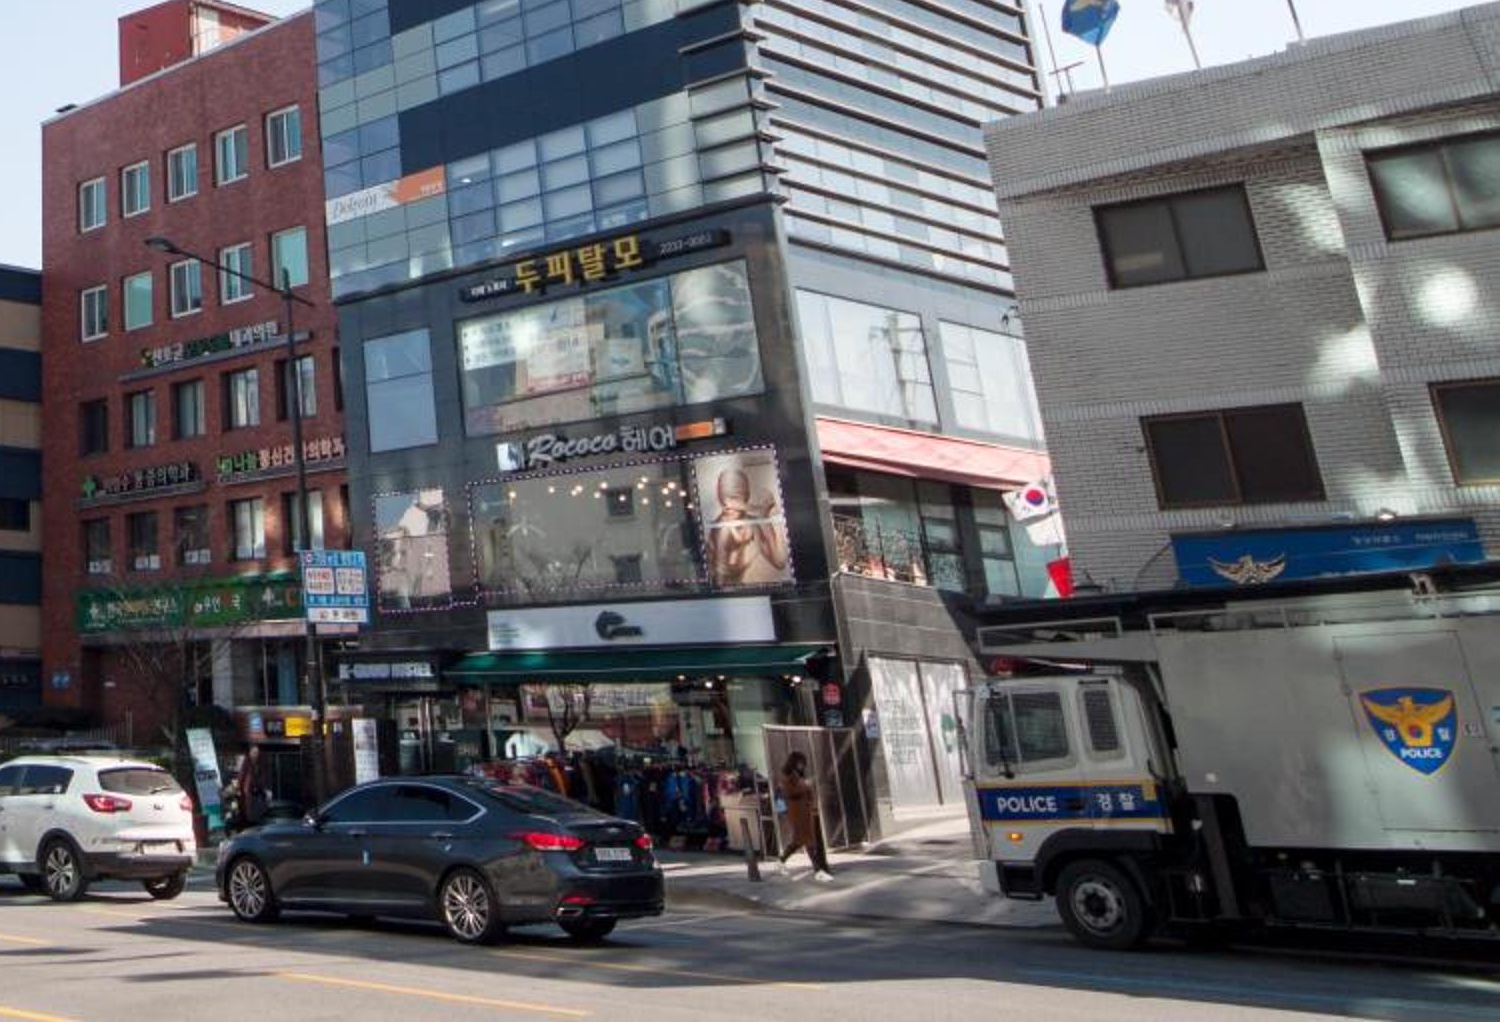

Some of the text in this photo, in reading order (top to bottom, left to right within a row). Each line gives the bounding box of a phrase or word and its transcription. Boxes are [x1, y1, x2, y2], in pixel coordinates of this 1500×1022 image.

[515, 235, 643, 295] 두피탈모
[526, 425, 677, 466] Rococo 헤어
[1400, 748, 1444, 759] POLICE
[997, 796, 1059, 813] POLICE
